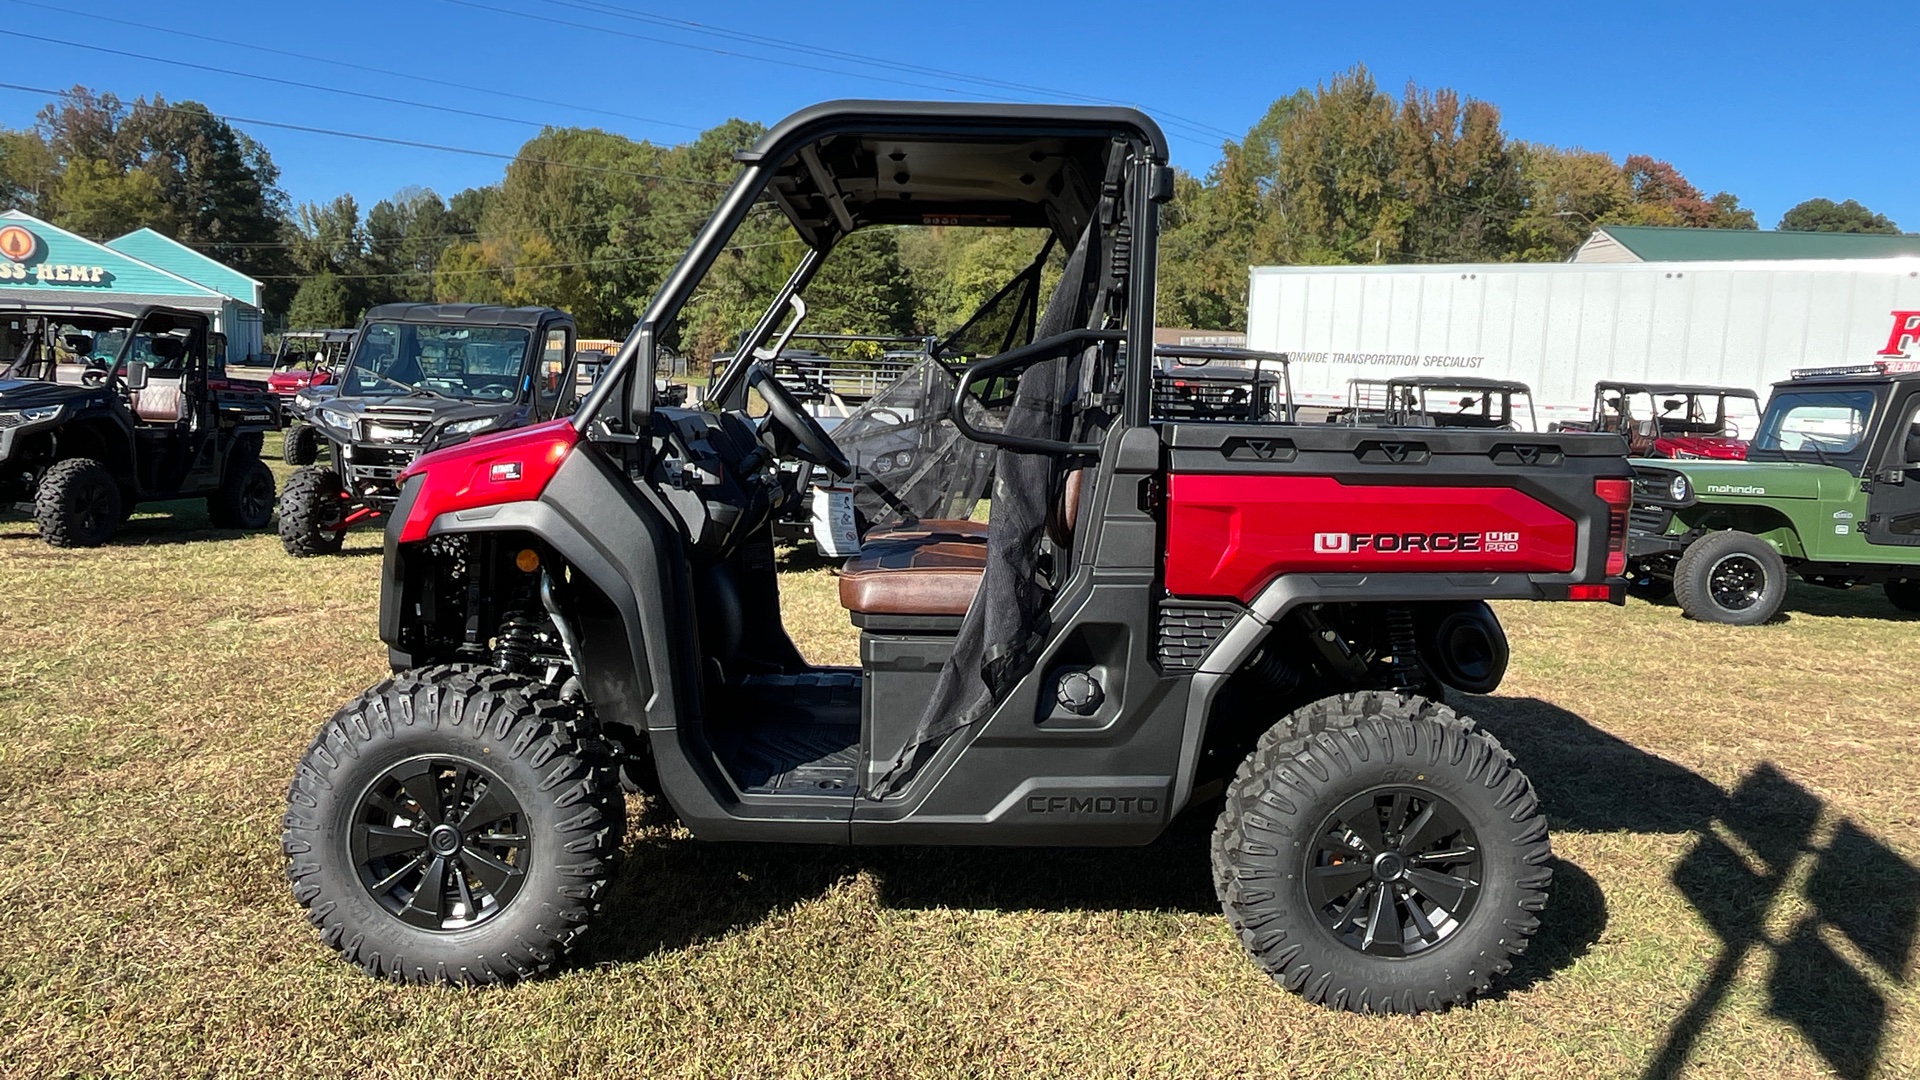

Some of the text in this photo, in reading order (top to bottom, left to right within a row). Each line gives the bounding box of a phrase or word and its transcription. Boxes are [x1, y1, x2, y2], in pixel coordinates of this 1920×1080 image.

[36, 263, 104, 282] HEMP
[1332, 353, 1420, 366] TRANSPORTATION
[1423, 355, 1484, 368] SPECIALIST
[1707, 484, 1765, 495] mahindra
[1485, 532, 1519, 542] U10
[1485, 543, 1519, 552] PRO
[1026, 796, 1158, 814] CFMOTO
